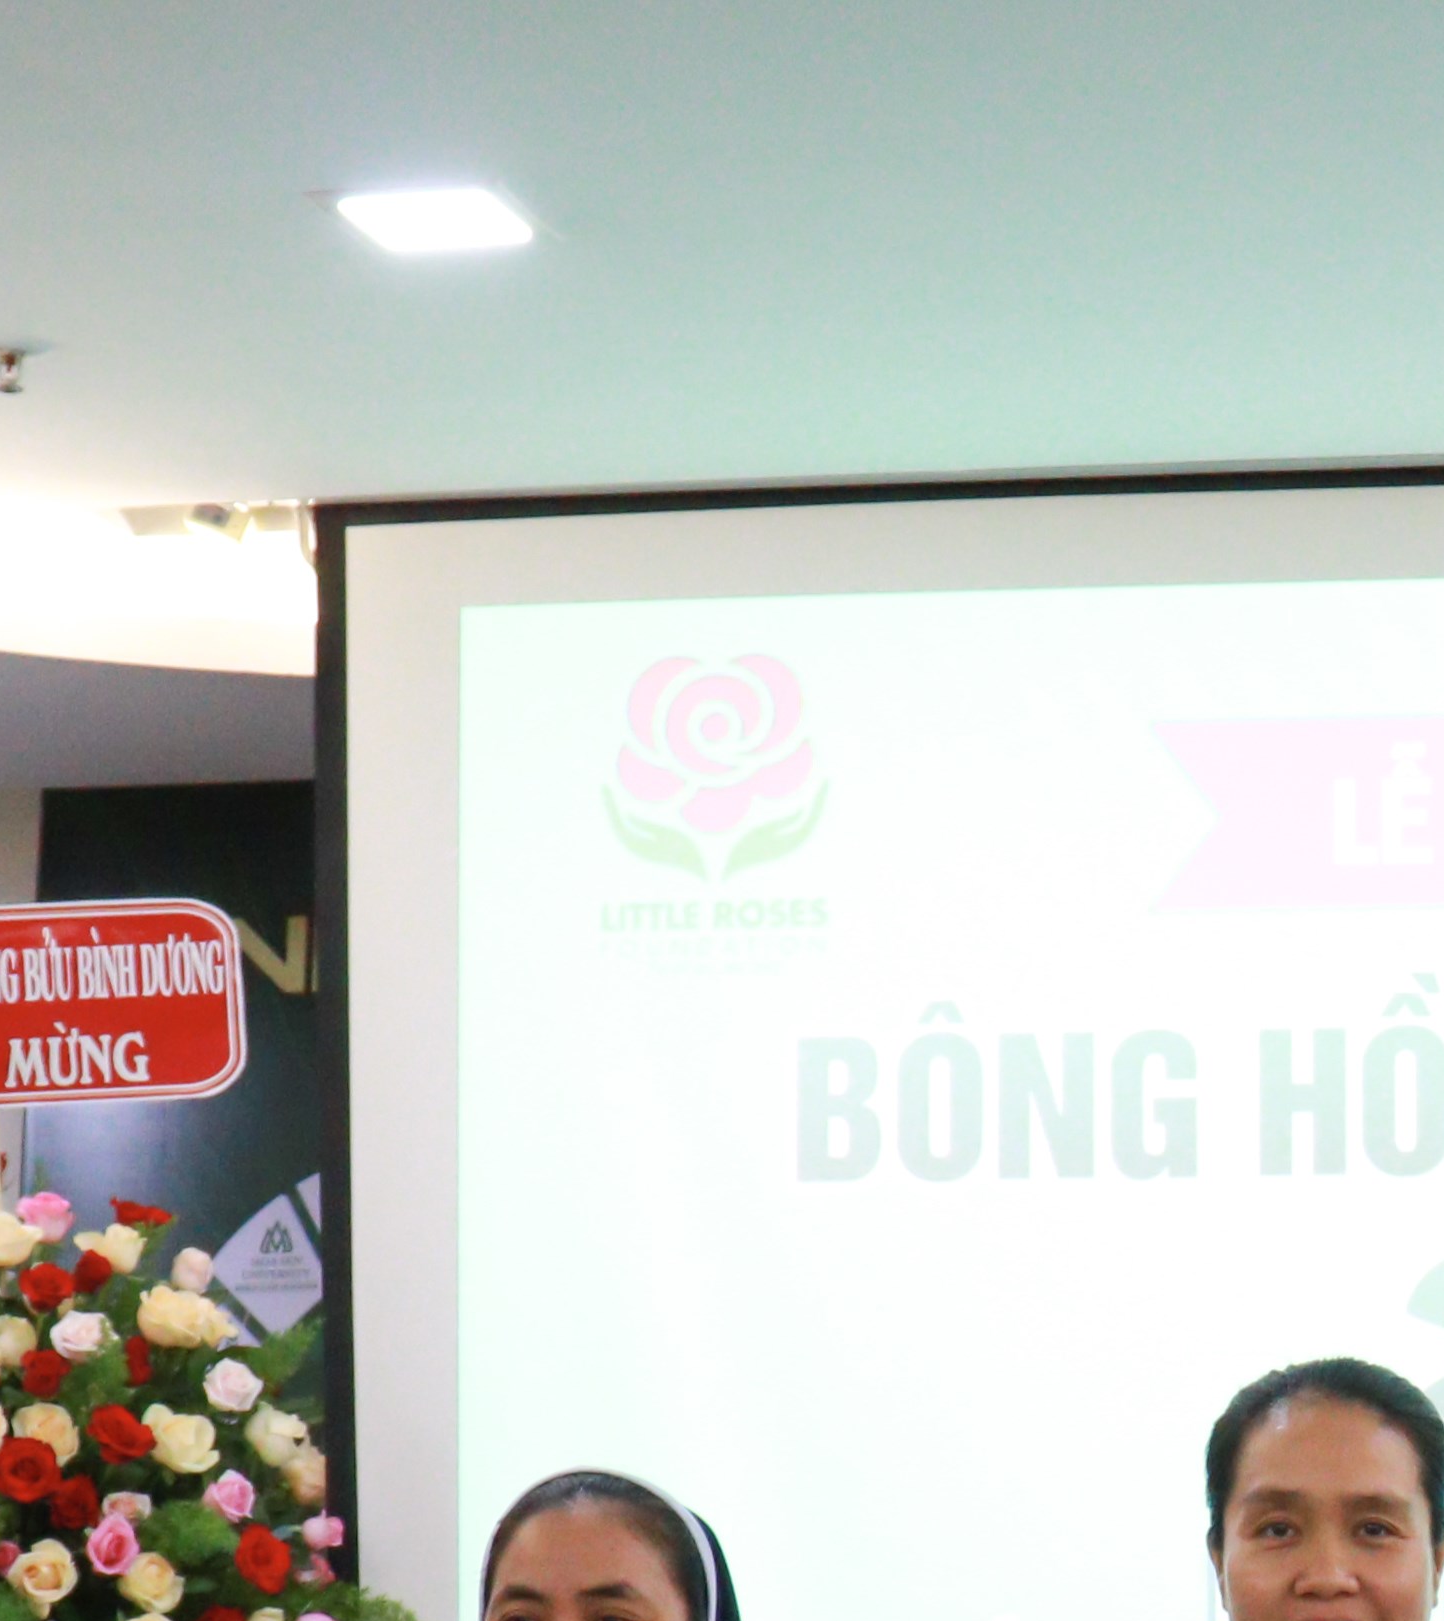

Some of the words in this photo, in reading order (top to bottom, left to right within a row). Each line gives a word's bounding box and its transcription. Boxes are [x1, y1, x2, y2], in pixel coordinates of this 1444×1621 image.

[1331, 741, 1435, 868] LỄ
[600, 899, 700, 932] LITTLE
[712, 896, 829, 929] ROSES
[24, 926, 75, 1003] BỬU
[76, 927, 137, 999] BÌNH
[141, 934, 225, 997] DƯƠNG
[4, 1021, 151, 1089] MỪNG
[795, 1000, 1199, 1183] BÔNG
